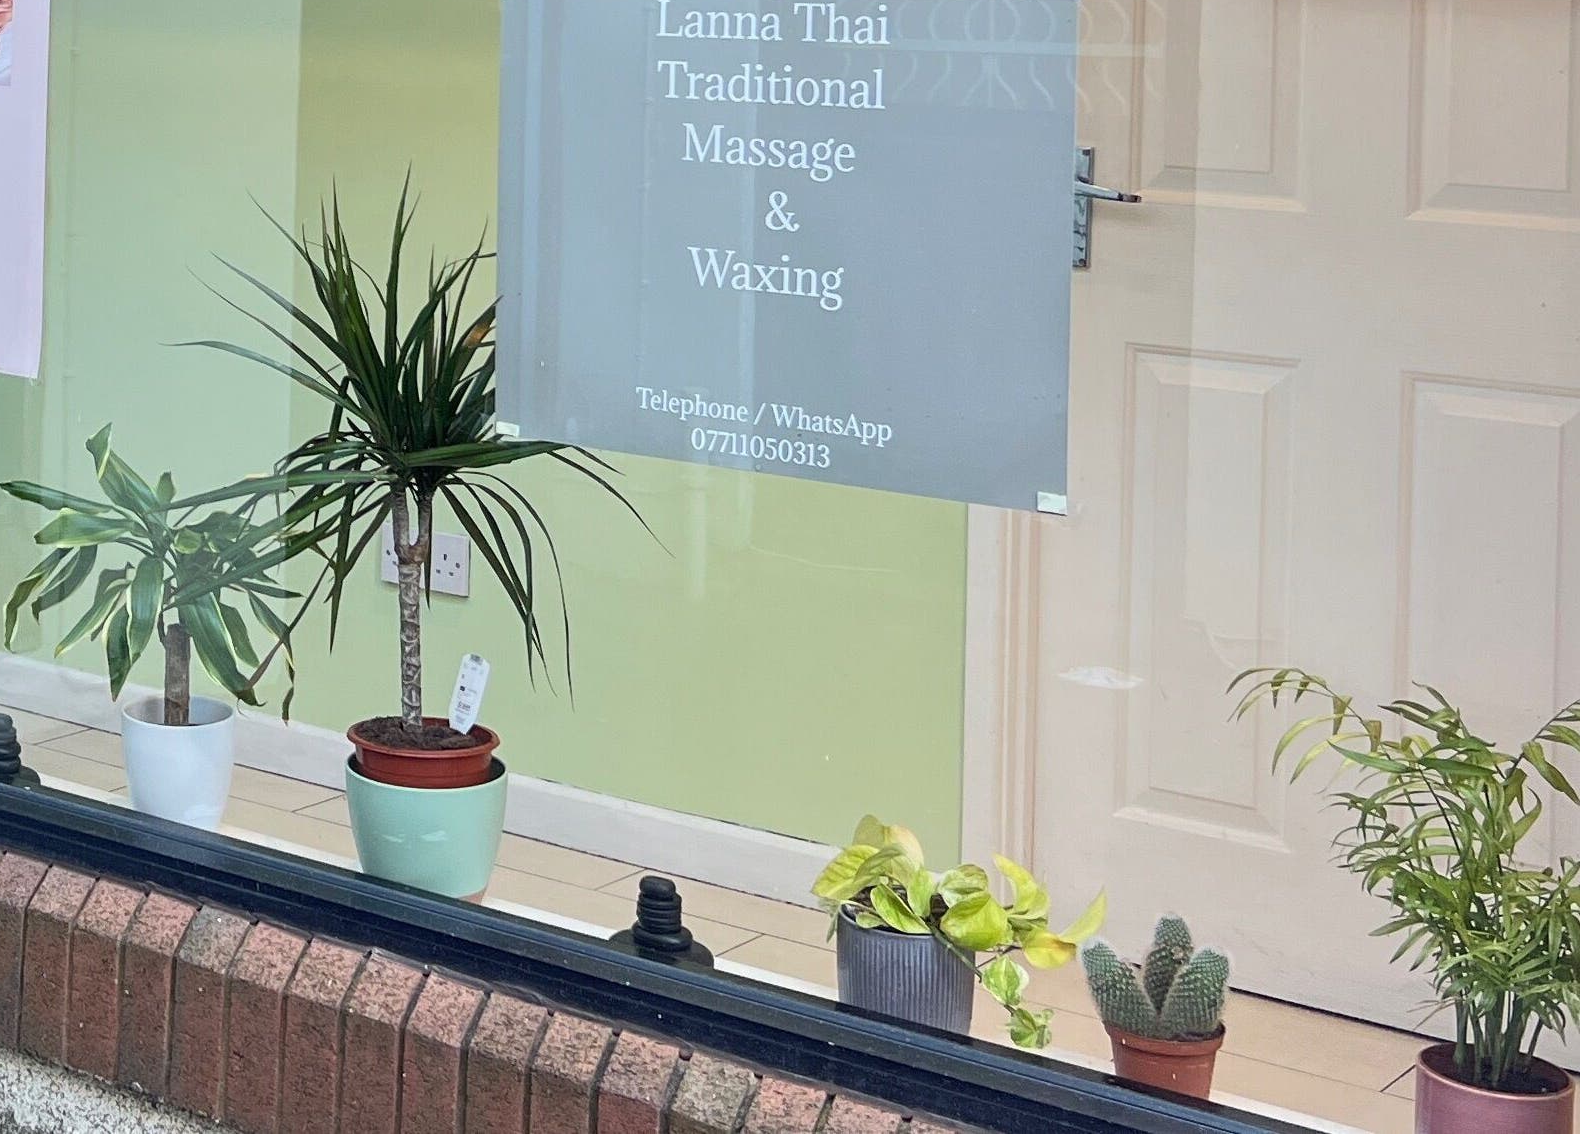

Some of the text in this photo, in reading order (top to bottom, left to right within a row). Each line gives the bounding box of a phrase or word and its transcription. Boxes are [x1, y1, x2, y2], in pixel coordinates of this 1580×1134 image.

[793, 1, 891, 46] Thai
[656, 60, 886, 110] Traditional
[681, 122, 856, 182] Massage
[764, 190, 800, 232] &
[687, 246, 845, 311] Waxing
[636, 386, 893, 448] Telephone / WhatsApp
[691, 428, 831, 468] 07711050313
